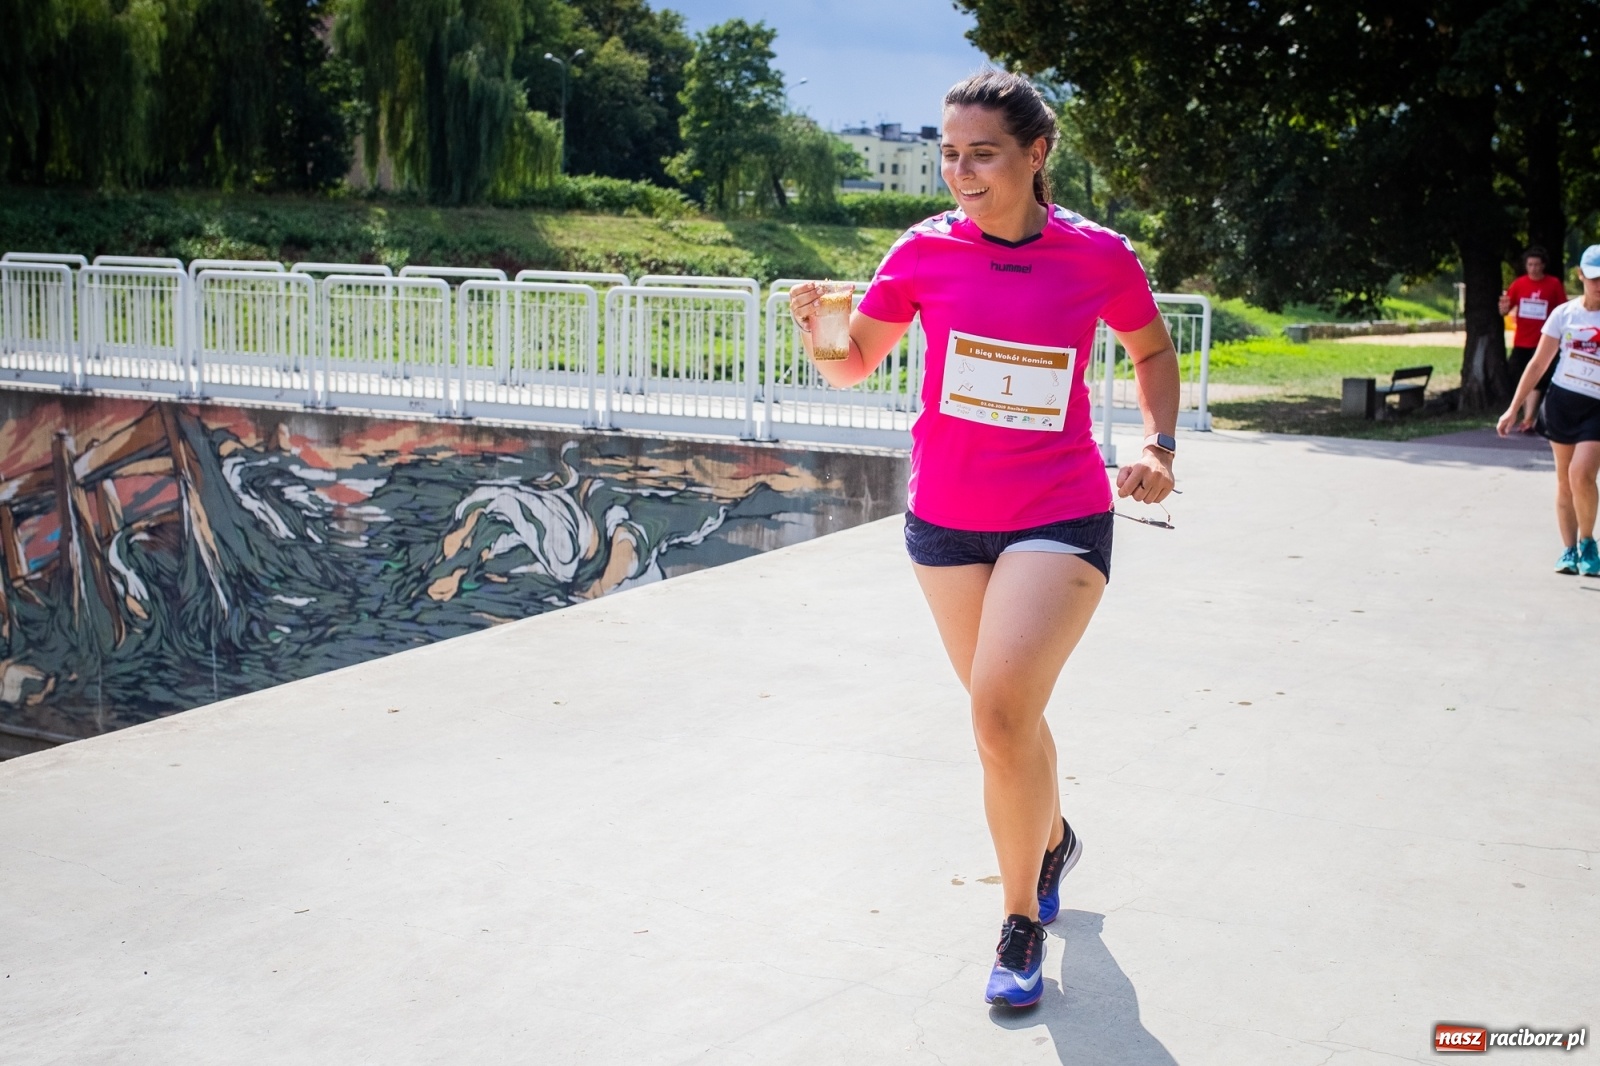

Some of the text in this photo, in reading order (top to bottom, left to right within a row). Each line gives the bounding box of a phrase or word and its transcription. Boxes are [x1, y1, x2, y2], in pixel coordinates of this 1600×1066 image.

[990, 260, 1032, 274] hummel
[975, 348, 993, 359] Bieg
[995, 352, 1020, 362] Wokół
[1022, 356, 1054, 365] Komina
[1581, 366, 1595, 377] 37
[1000, 375, 1013, 396] 1
